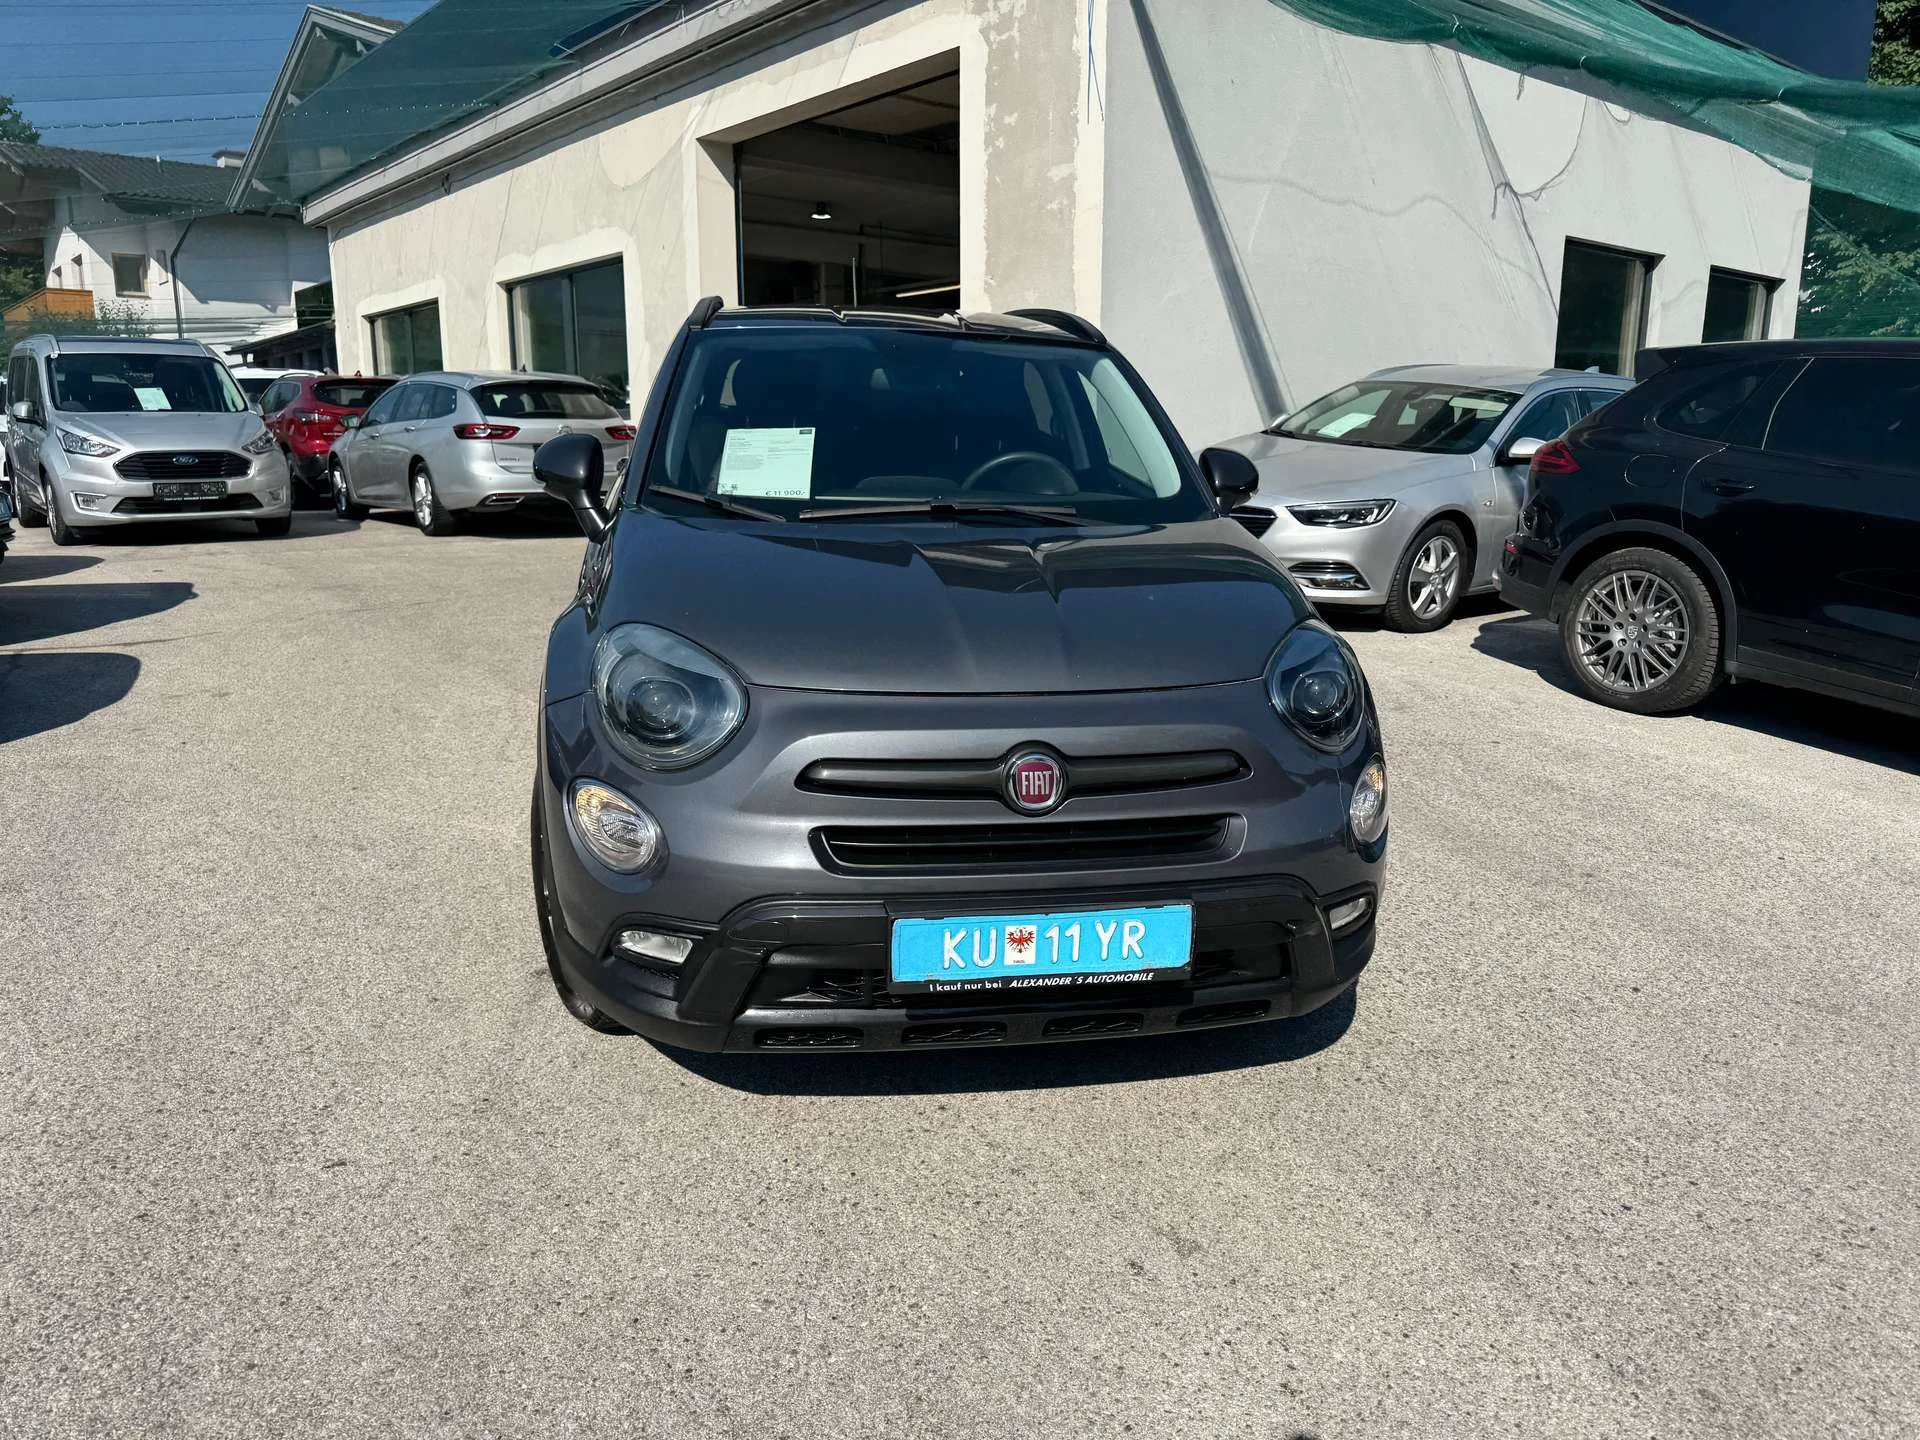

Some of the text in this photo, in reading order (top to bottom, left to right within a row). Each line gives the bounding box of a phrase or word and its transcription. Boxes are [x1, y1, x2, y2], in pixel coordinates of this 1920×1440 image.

[1021, 771, 1052, 795] FIAT
[943, 919, 1146, 969] KU 11 YR
[936, 982, 962, 991] kauf
[985, 980, 1002, 989] bei
[1085, 972, 1155, 984] AUTOMOBILE
